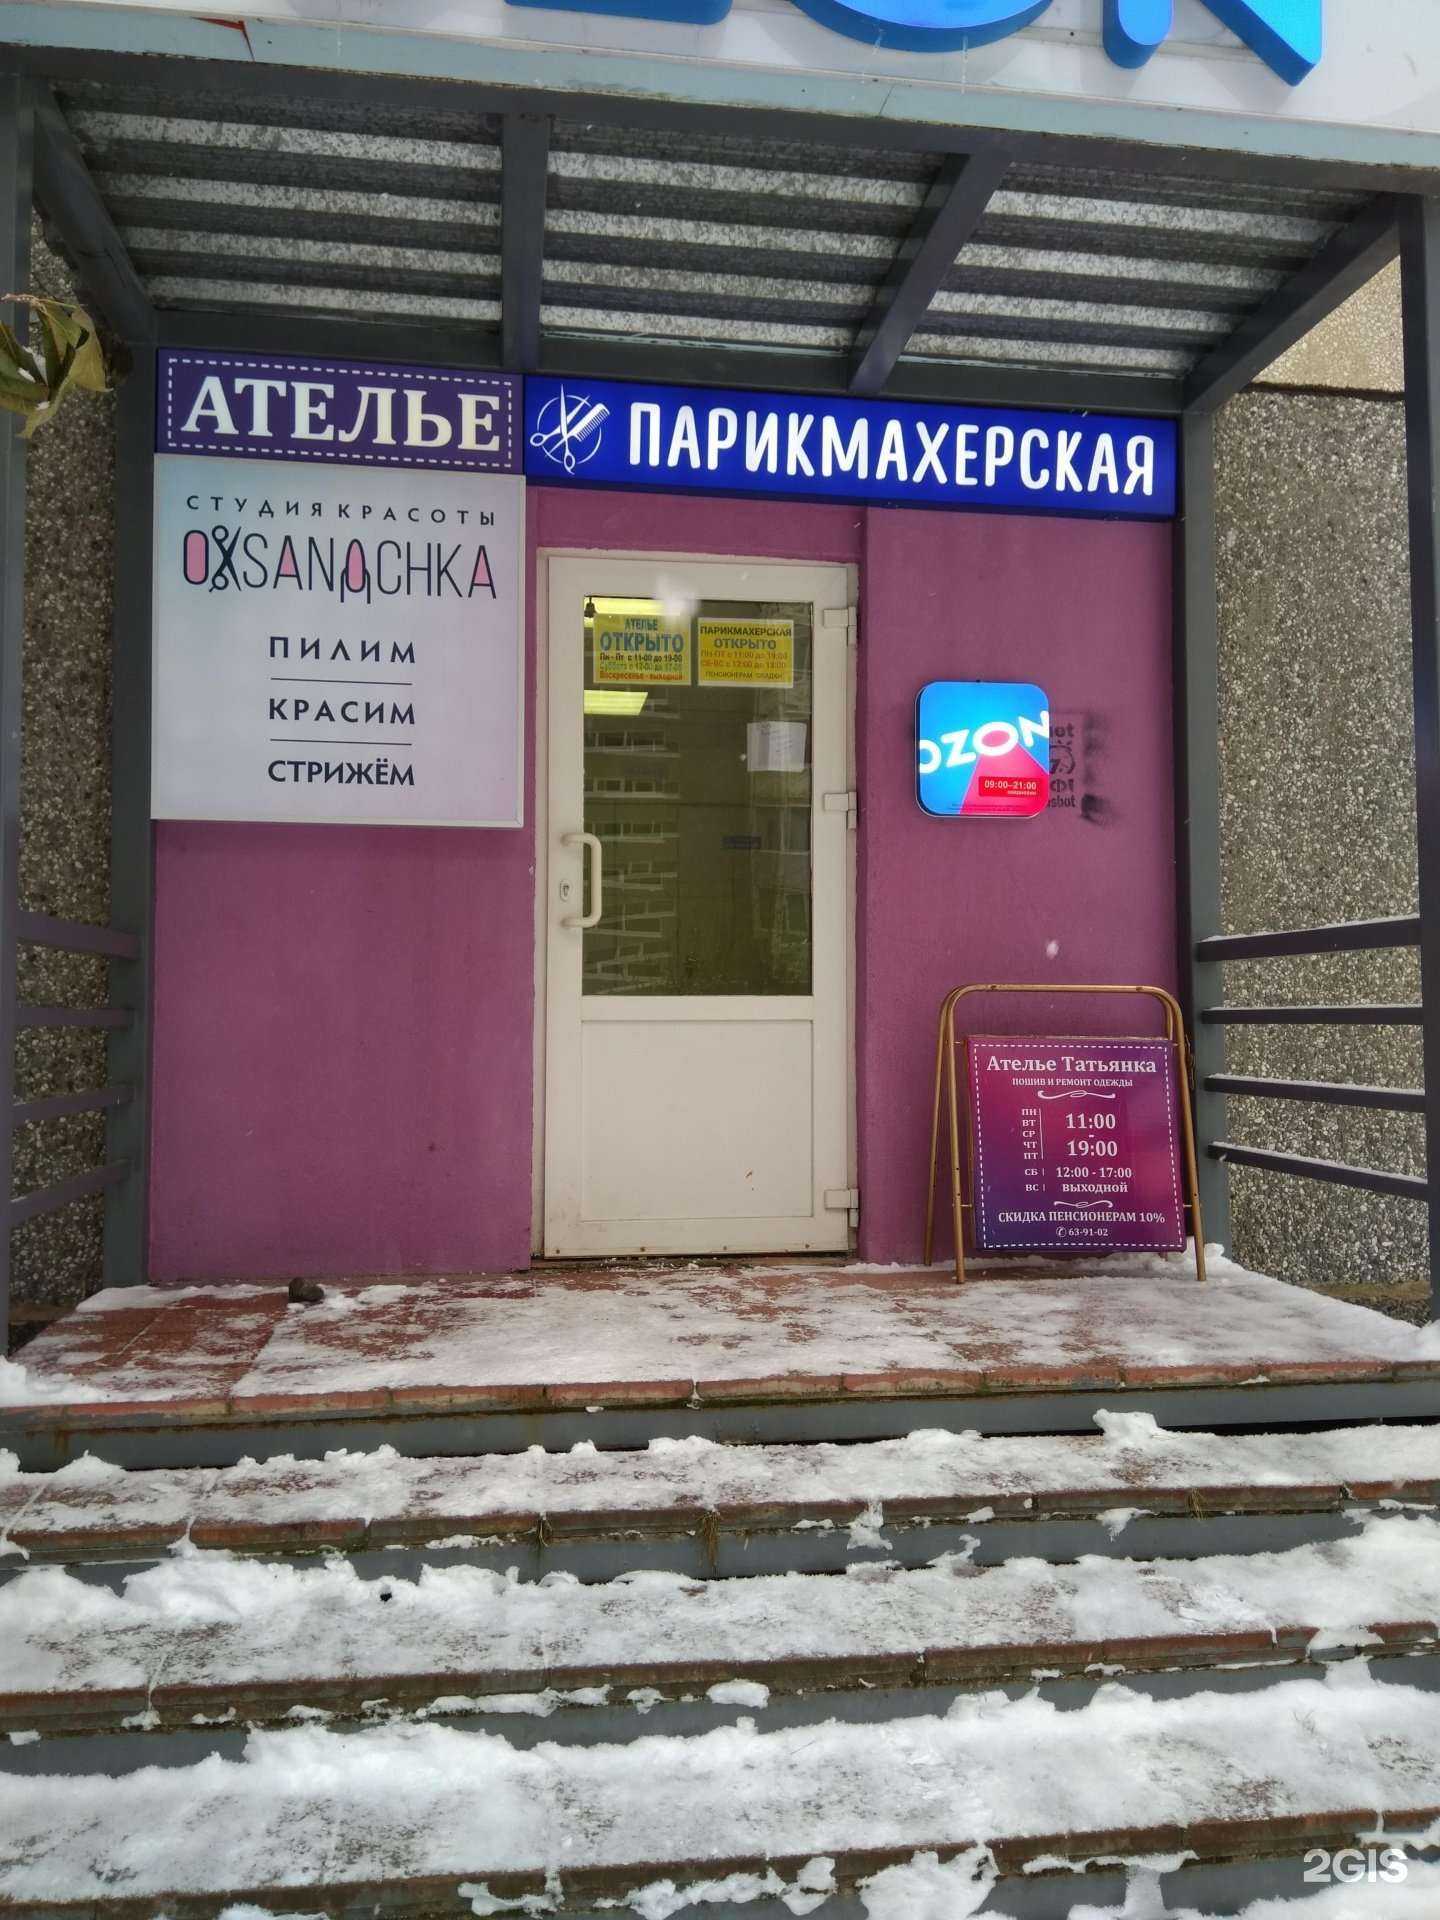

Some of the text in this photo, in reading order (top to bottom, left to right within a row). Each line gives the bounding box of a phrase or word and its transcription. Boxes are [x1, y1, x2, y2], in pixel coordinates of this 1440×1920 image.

[181, 376, 500, 451] АТЕЛЬЕ
[629, 402, 1155, 496] ПАРИКМАХЕРСКАЯ
[186, 495, 496, 527] СТУДИЯ КРАСОТЫ
[624, 617, 658, 630] АТЕЛЬЕ
[700, 625, 792, 637] ПАРИКМАХЕРСКАЯ
[600, 632, 684, 653] ОТКРЫТО
[714, 639, 777, 650] ОТКРЫТО
[270, 636, 415, 663] ПИЛИМ
[269, 698, 415, 725] КРАСИМ
[919, 711, 1050, 774] OZON
[269, 758, 415, 786] СТРИЖЁМ
[986, 1055, 1157, 1073] Ателье Татьянка
[1012, 1078, 1133, 1088] ПОШИВ И РЕМОНТ ОДЕЖДЫ
[1021, 1108, 1037, 1116] ПН
[1022, 1119, 1036, 1127] ВТ
[1065, 1113, 1116, 1129] 11:00
[1022, 1130, 1036, 1138] СР
[1023, 1141, 1037, 1149] ЧТ
[1066, 1140, 1118, 1157] 19:00
[1023, 1152, 1038, 1160] ПТ
[1024, 1168, 1038, 1176] СБ
[1056, 1167, 1089, 1178] 12:00
[1100, 1167, 1132, 1178] 17:00
[1025, 1184, 1039, 1192] ВС
[998, 1212, 1166, 1224] СКИДКА ПЕНСИОНЕРАМ 10%
[1068, 1227, 1108, 1237] 63-91-02
